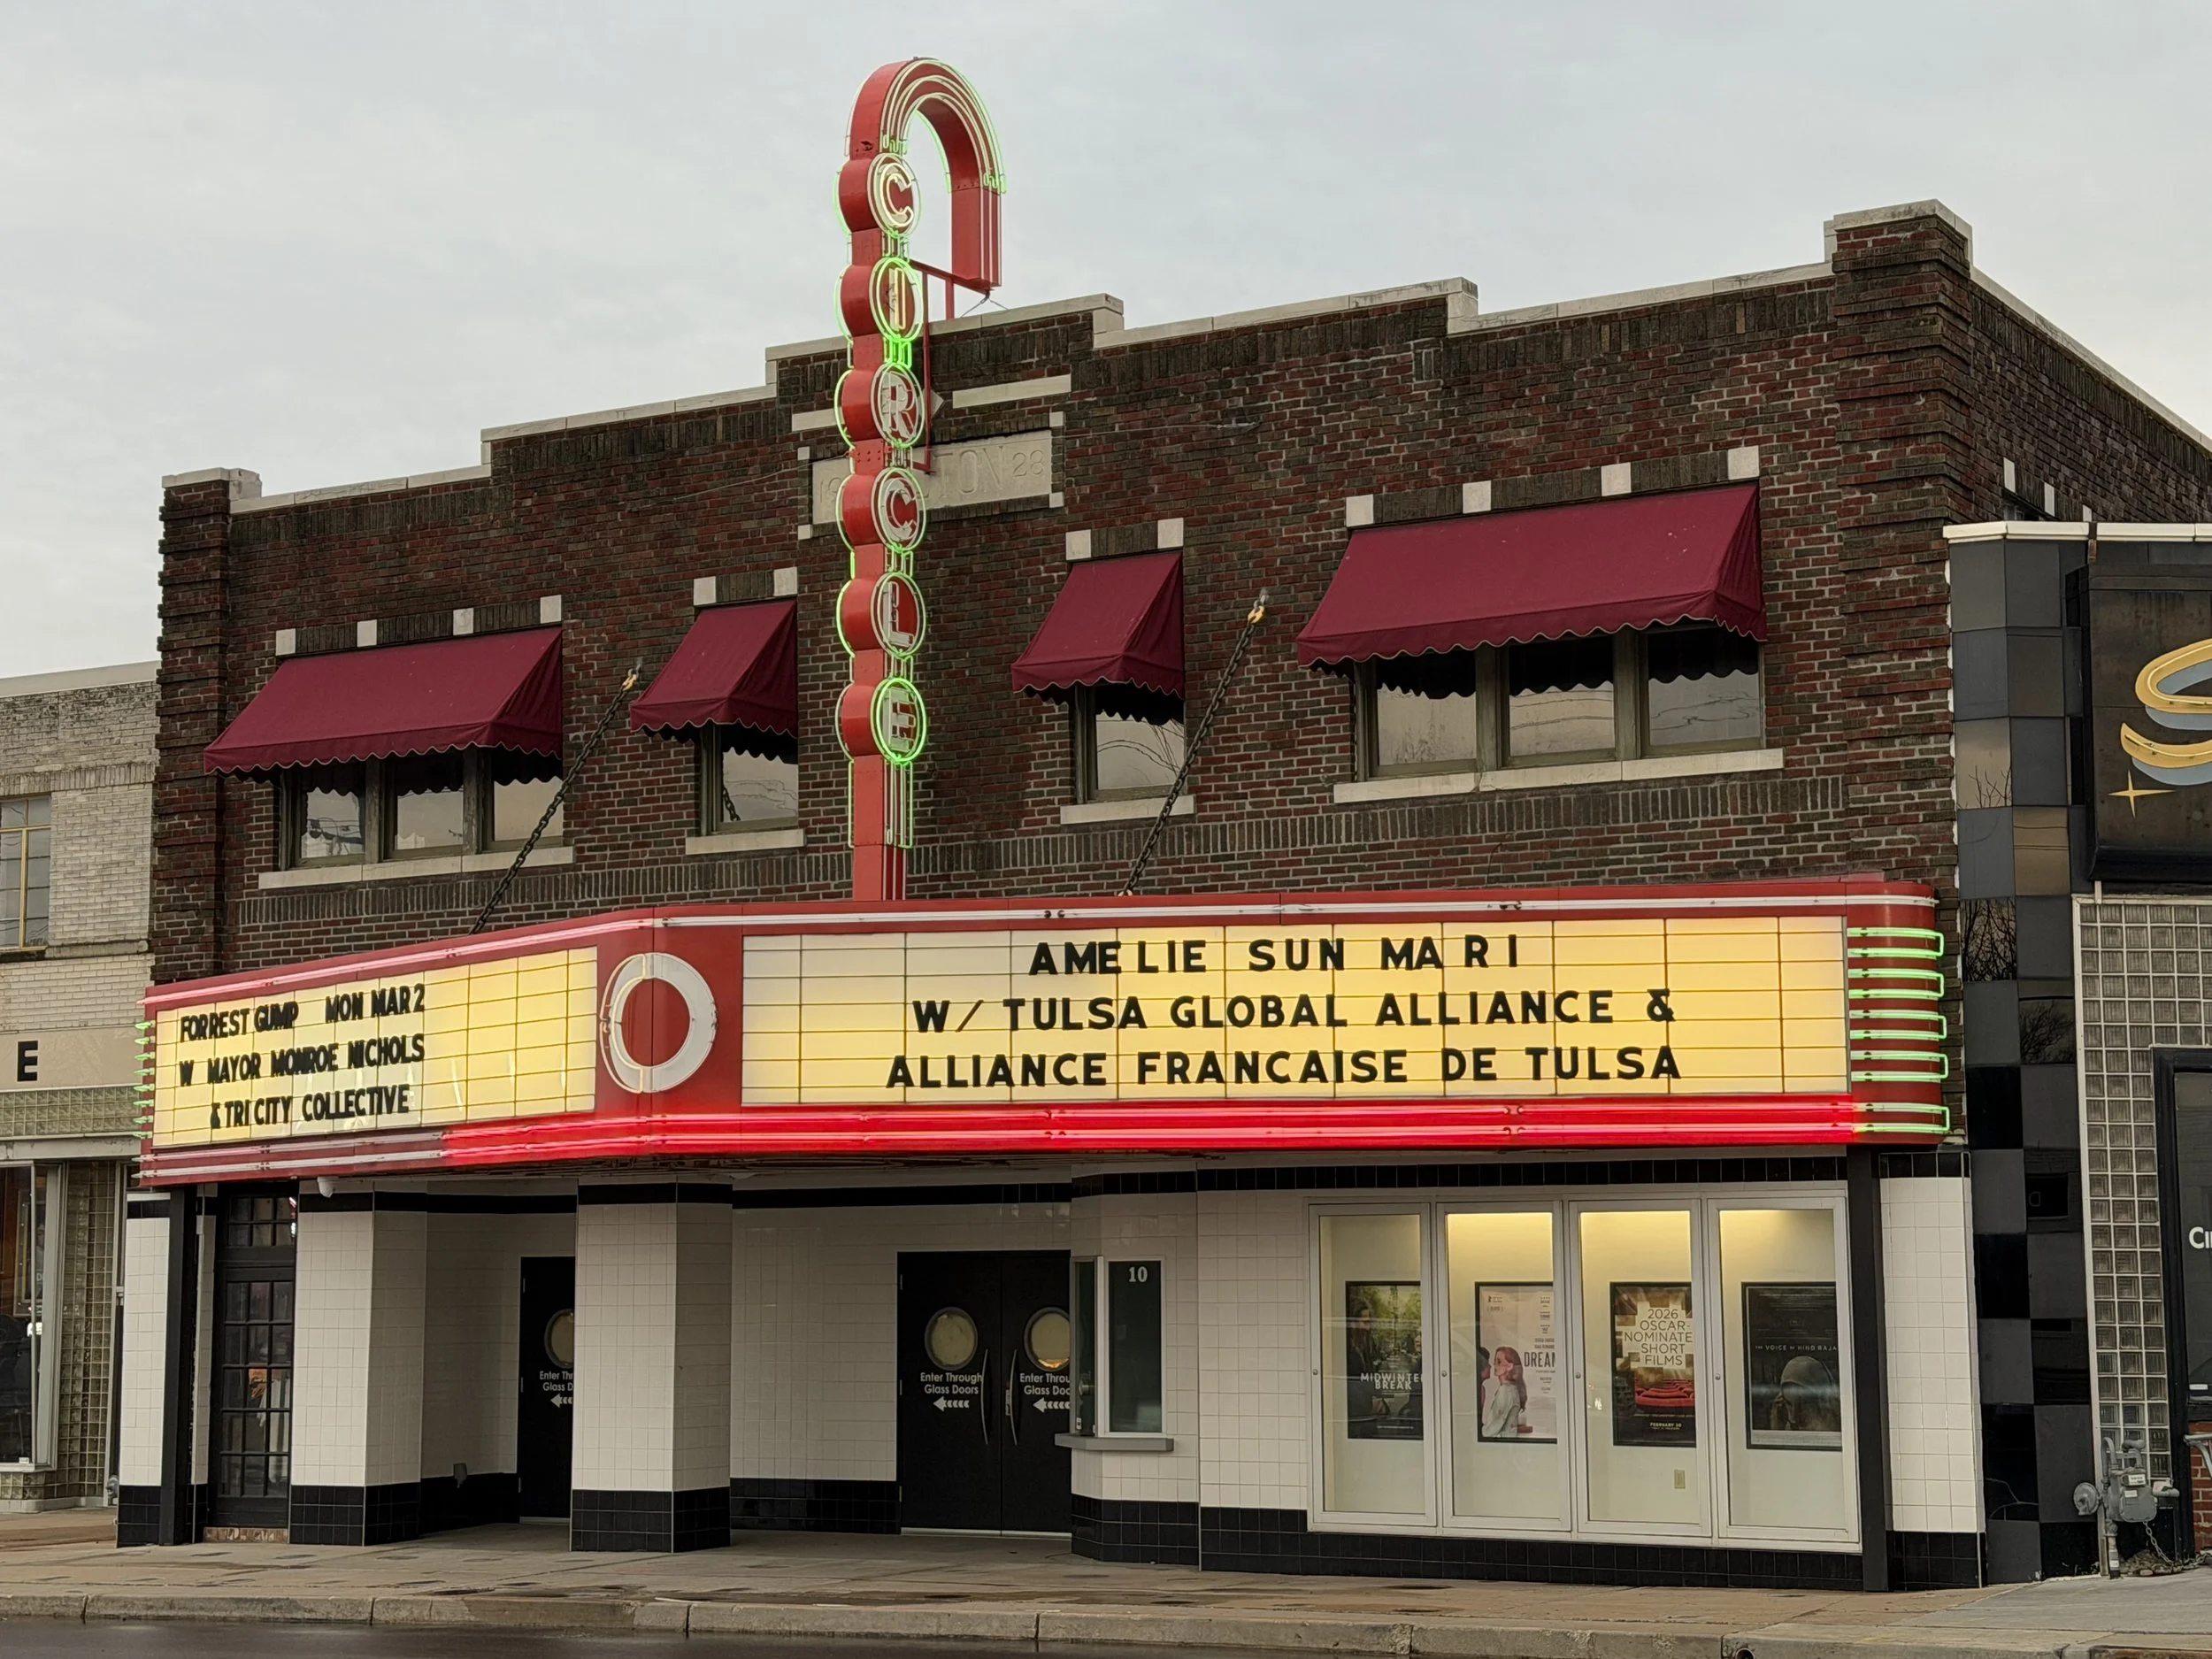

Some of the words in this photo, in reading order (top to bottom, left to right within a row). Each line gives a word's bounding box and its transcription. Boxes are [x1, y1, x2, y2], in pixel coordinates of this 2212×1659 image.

[879, 162, 918, 753] CIRCLE
[1011, 450, 1045, 478] 28
[1028, 940, 1205, 976] AMELIE
[1248, 938, 1344, 972] SUN
[1381, 934, 1517, 971] MARI
[180, 1009, 250, 1042] FORREST
[254, 1001, 299, 1033] GUMP
[326, 992, 364, 1023] MON
[371, 986, 411, 1018] MAR
[413, 983, 426, 1012] 2
[1002, 996, 1148, 1032] TULSA
[1171, 995, 1348, 1028] GLOBAL
[1376, 989, 1613, 1026] ALLIANCE
[1647, 988, 1676, 1022] &
[17, 1041, 38, 1082] E
[180, 1060, 194, 1087] W
[208, 1052, 261, 1084] MAYOR
[271, 1042, 339, 1077] MONROE
[348, 1033, 425, 1069] NICHOLS
[887, 1053, 1107, 1089] ALLIANCE
[1138, 1049, 1408, 1086] FRANCAISE
[1441, 1048, 1497, 1082] DE
[1525, 1045, 1682, 1081] TULSA
[224, 1100, 250, 1128] TRI
[254, 1096, 293, 1126] CITY
[302, 1084, 410, 1122] COLLECTIVE
[1128, 1266, 1148, 1282] 10
[1647, 1309, 1678, 1319] 2026
[1640, 1320, 1690, 1331] OSCAR-
[1640, 1343, 1686, 1354] SHORT
[1645, 1355, 1683, 1365] FILMS
[539, 1371, 560, 1380] Enter
[920, 1372, 943, 1382] Enter
[946, 1372, 982, 1385] Through
[1019, 1373, 1043, 1383] Enter
[542, 1382, 565, 1392] Glass
[924, 1384, 949, 1394] Glass
[952, 1384, 979, 1394] Doors
[1024, 1385, 1050, 1395] Glass
[1374, 1380, 1412, 1390] BREAK
